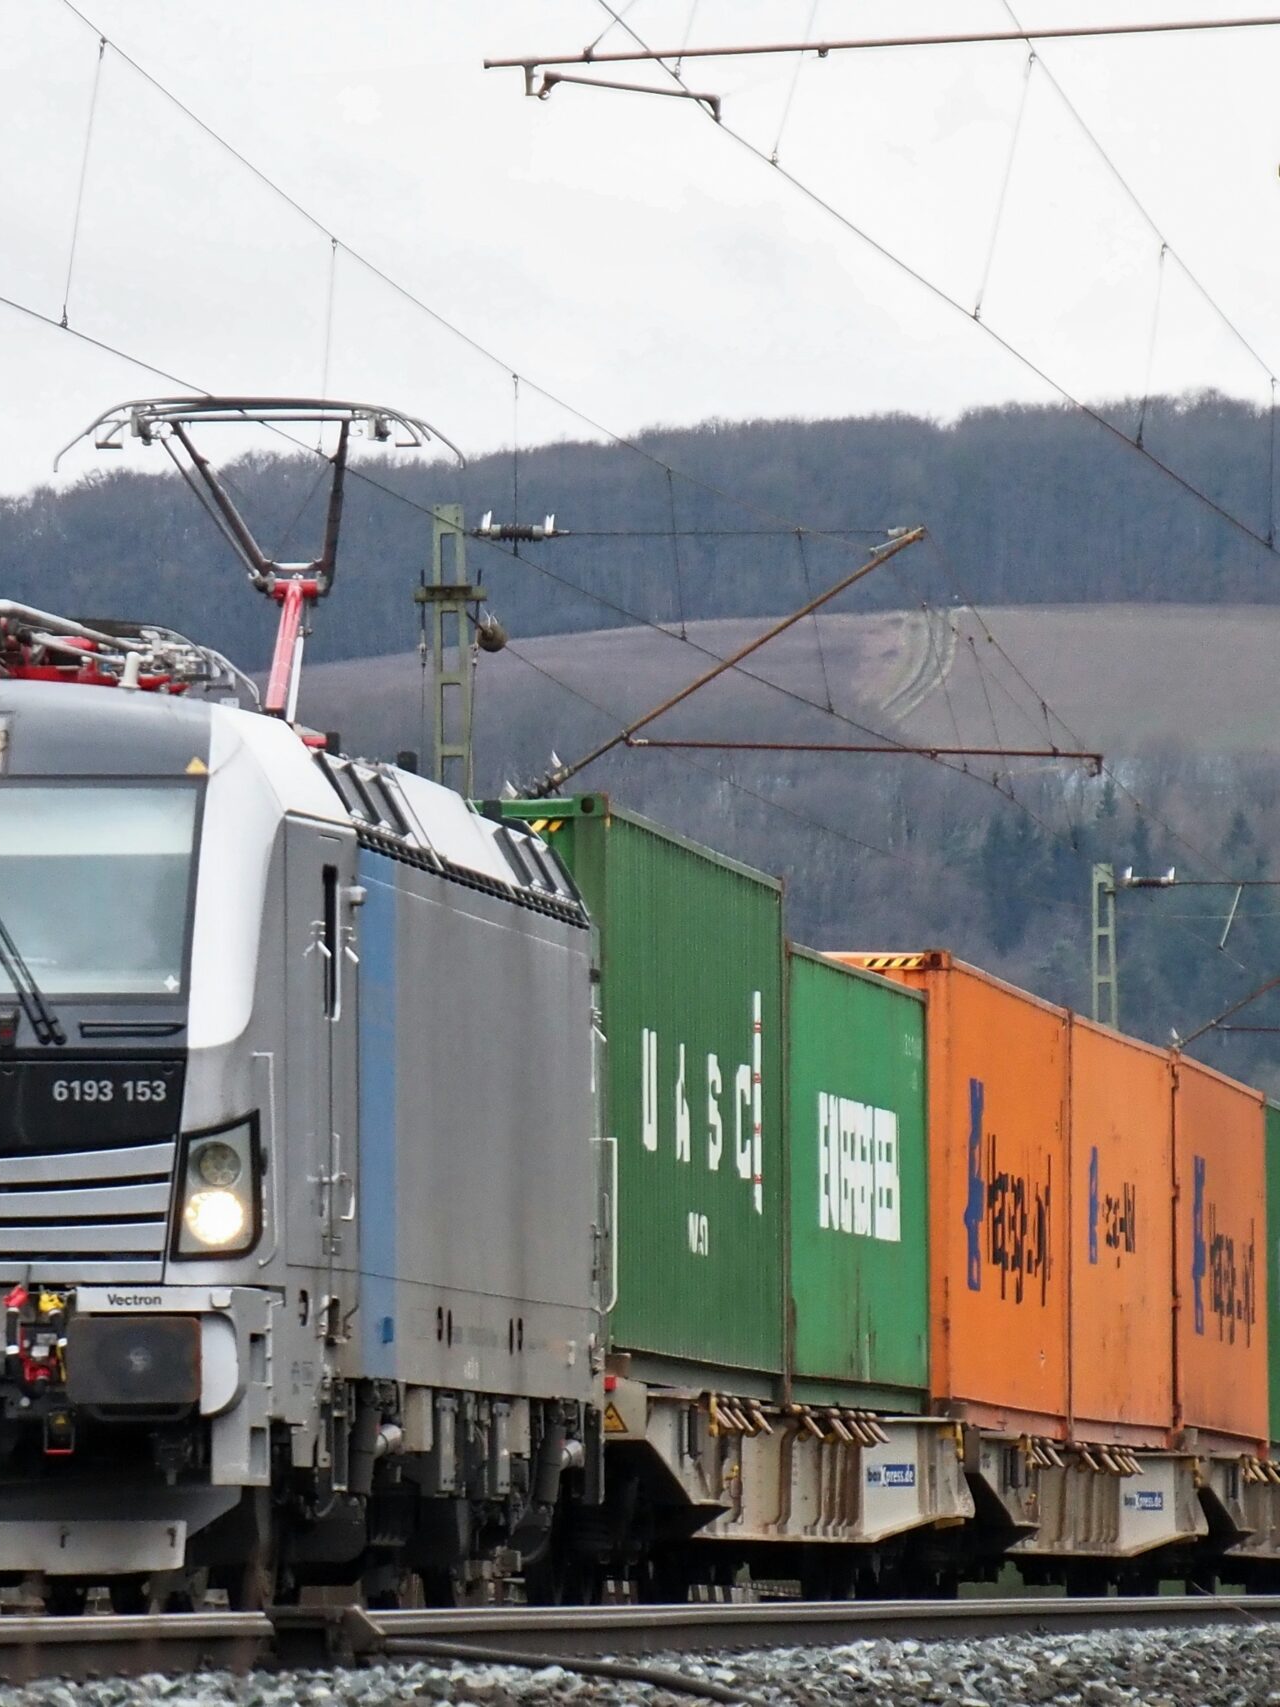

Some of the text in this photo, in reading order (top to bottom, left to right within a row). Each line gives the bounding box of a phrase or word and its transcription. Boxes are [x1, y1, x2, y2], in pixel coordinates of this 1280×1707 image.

[53, 1079, 167, 1101] 6193 153
[107, 1293, 162, 1306] Vectron
